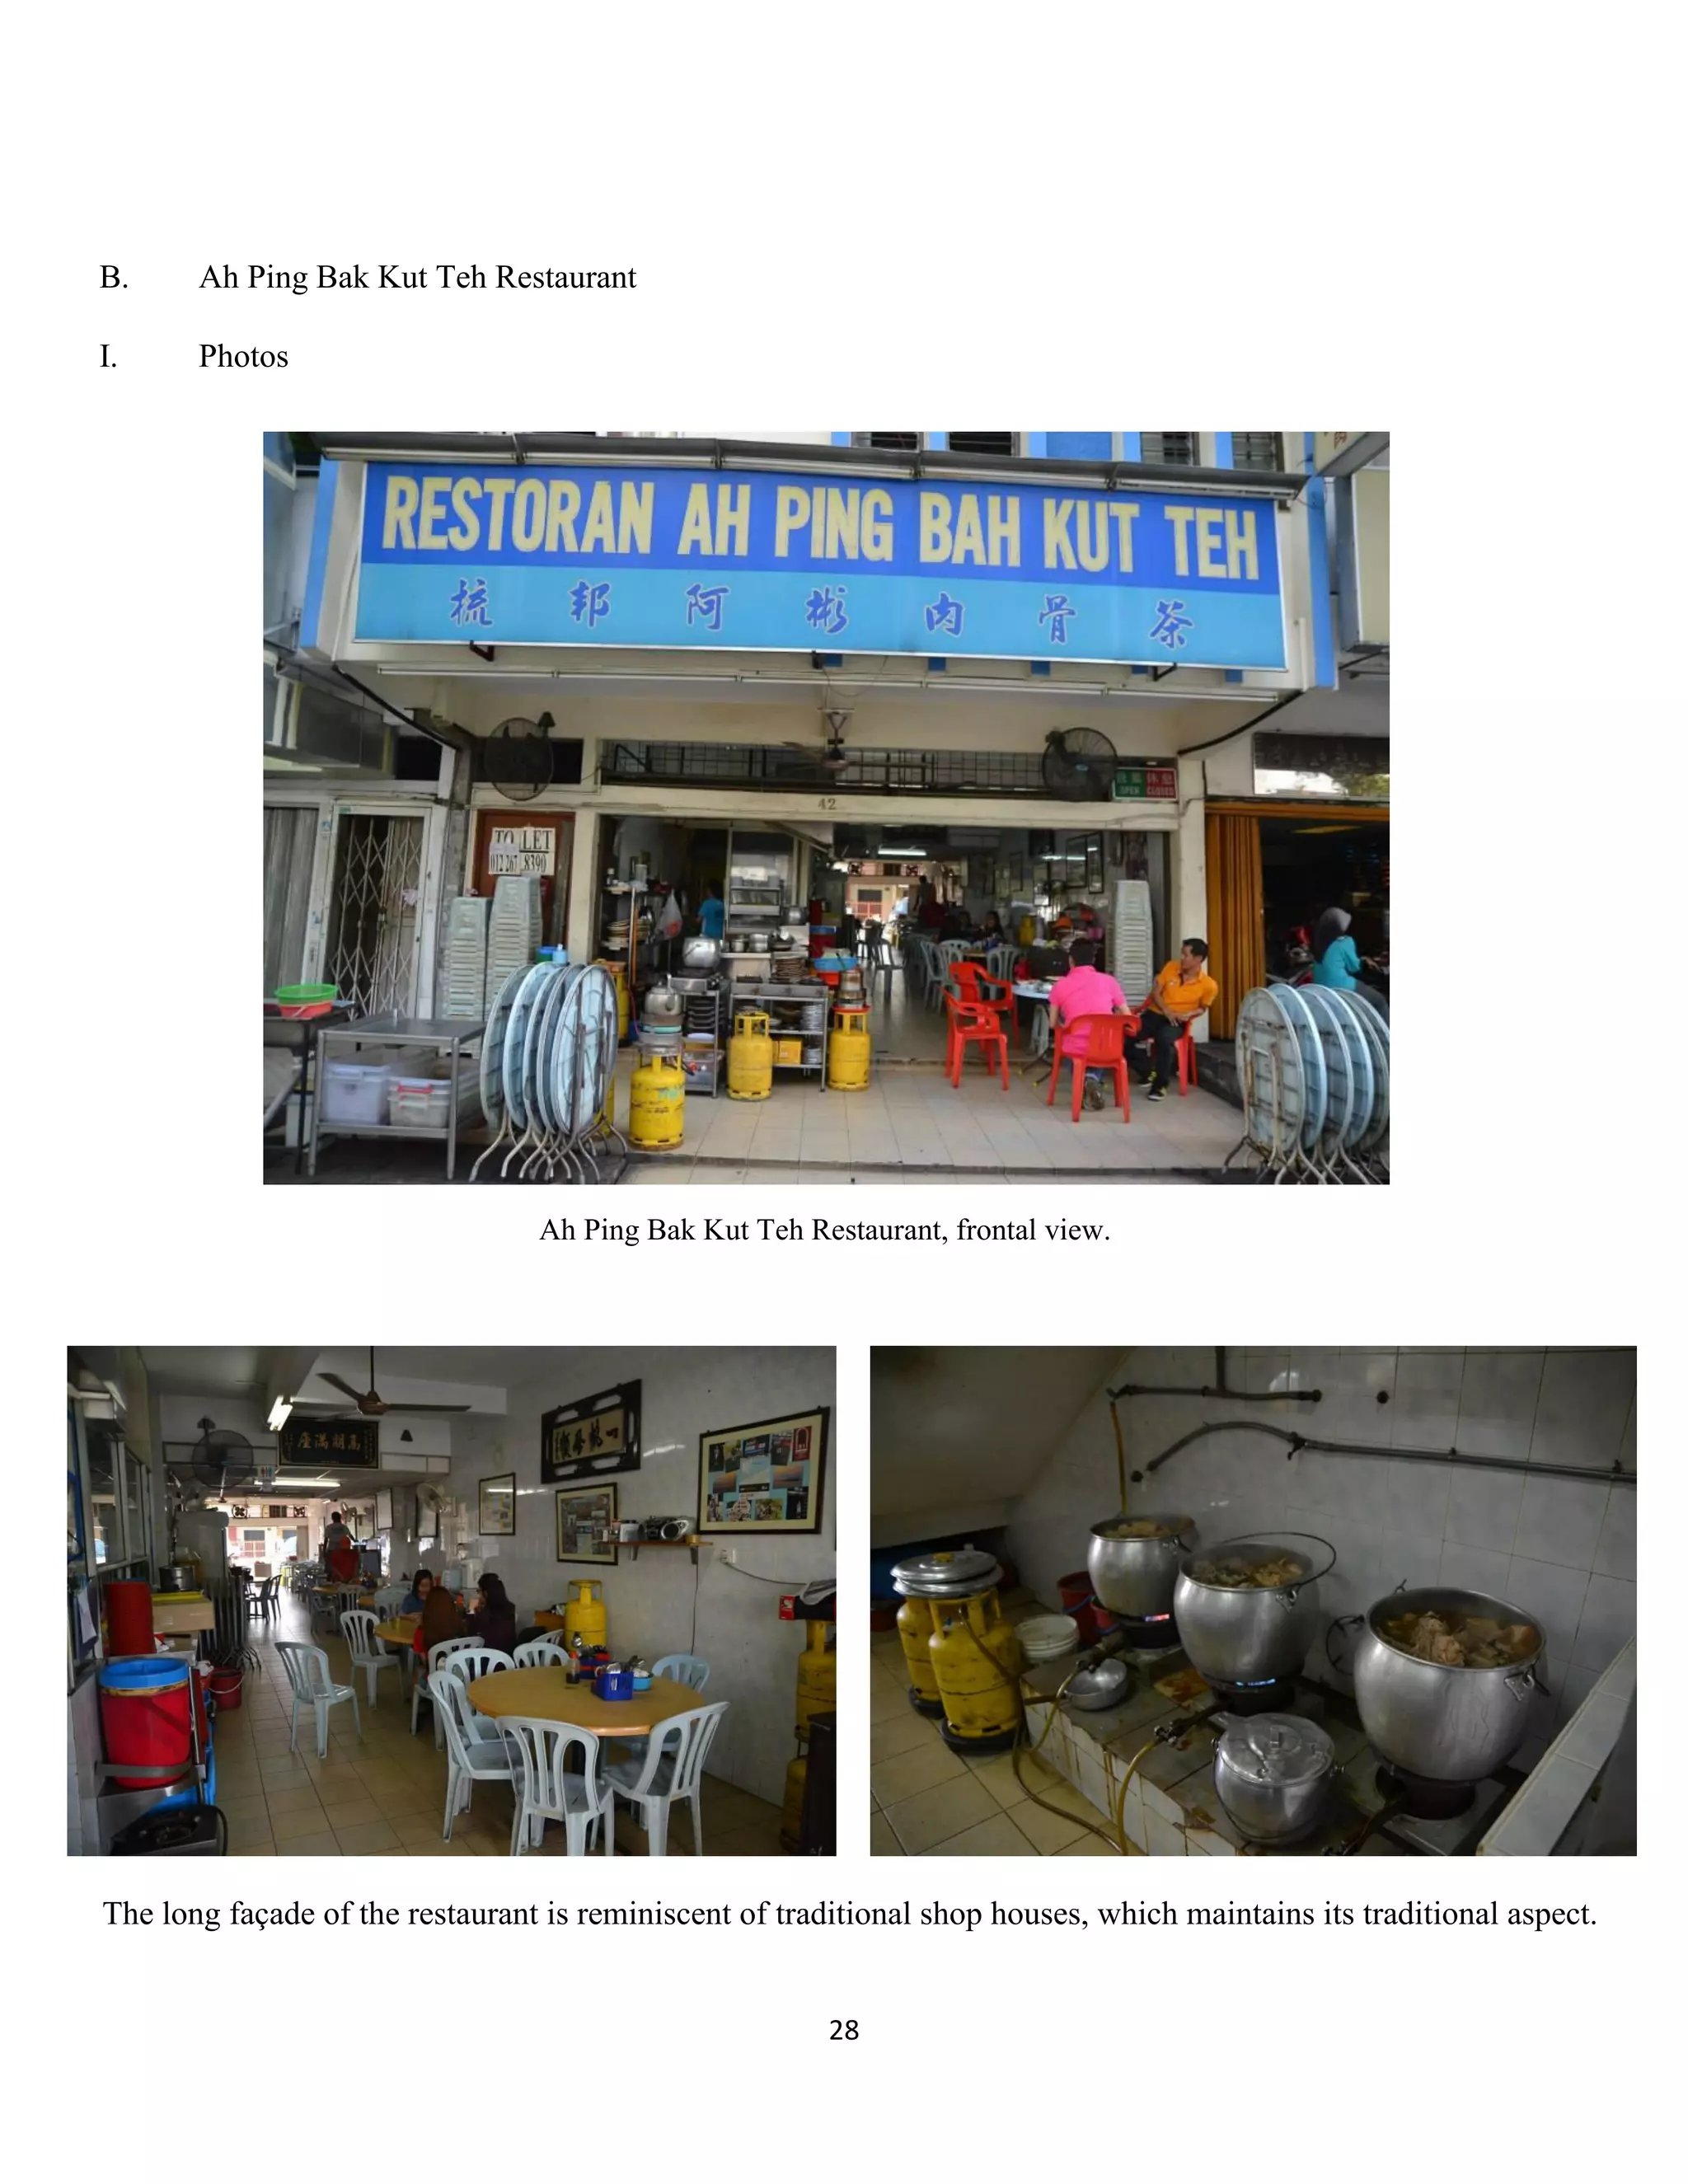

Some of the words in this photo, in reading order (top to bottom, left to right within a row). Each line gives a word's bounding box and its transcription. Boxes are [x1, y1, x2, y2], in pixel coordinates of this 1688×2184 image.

[100, 265, 127, 288] B.
[199, 265, 239, 288] Ah
[248, 265, 307, 295] Ping
[316, 265, 369, 288] Bak
[378, 265, 427, 288] Kut
[437, 265, 486, 288] Teh
[496, 265, 636, 288] Restaurant
[101, 344, 116, 367] I.
[199, 344, 288, 368] Photos
[382, 476, 654, 555] RESTORAN
[677, 483, 751, 556] AH
[775, 485, 893, 562] PING
[920, 492, 1020, 567] BAH
[1043, 498, 1139, 574] KUT
[1164, 505, 1259, 580] TEH
[450, 579, 1193, 649] 梳邦阿彬肉骨茶
[1146, 786, 1175, 796] CLOSED
[818, 798, 837, 810] 42
[495, 830, 514, 845] TO
[523, 830, 552, 850] LET
[524, 854, 547, 873] 8390
[539, 1218, 575, 1240] Ah
[584, 1218, 639, 1246] Ping
[648, 1218, 696, 1240] Bak
[704, 1218, 749, 1240] Kut
[757, 1218, 804, 1240] Teh
[812, 1218, 947, 1244] Restaurant,
[957, 1218, 1036, 1240] frontal
[1045, 1218, 1109, 1240] view.
[103, 1901, 152, 1924] The
[163, 1901, 220, 1931] long
[230, 1901, 314, 1930] façade
[324, 1901, 354, 1924] of
[359, 1901, 399, 1924] the
[408, 1905, 538, 1924] restaurant
[547, 1901, 568, 1924] is
[577, 1901, 731, 1924] reminiscent
[740, 1901, 771, 1924] of
[776, 1901, 911, 1924] traditional
[921, 1901, 982, 1931] shop
[991, 1901, 1087, 1929] houses,
[1098, 1901, 1178, 1924] which
[1187, 1901, 1314, 1924] maintains
[1325, 1901, 1353, 1924] its
[1363, 1901, 1498, 1924] traditional
[1508, 1905, 1596, 1931] aspect.
[830, 2020, 859, 2040] 28
